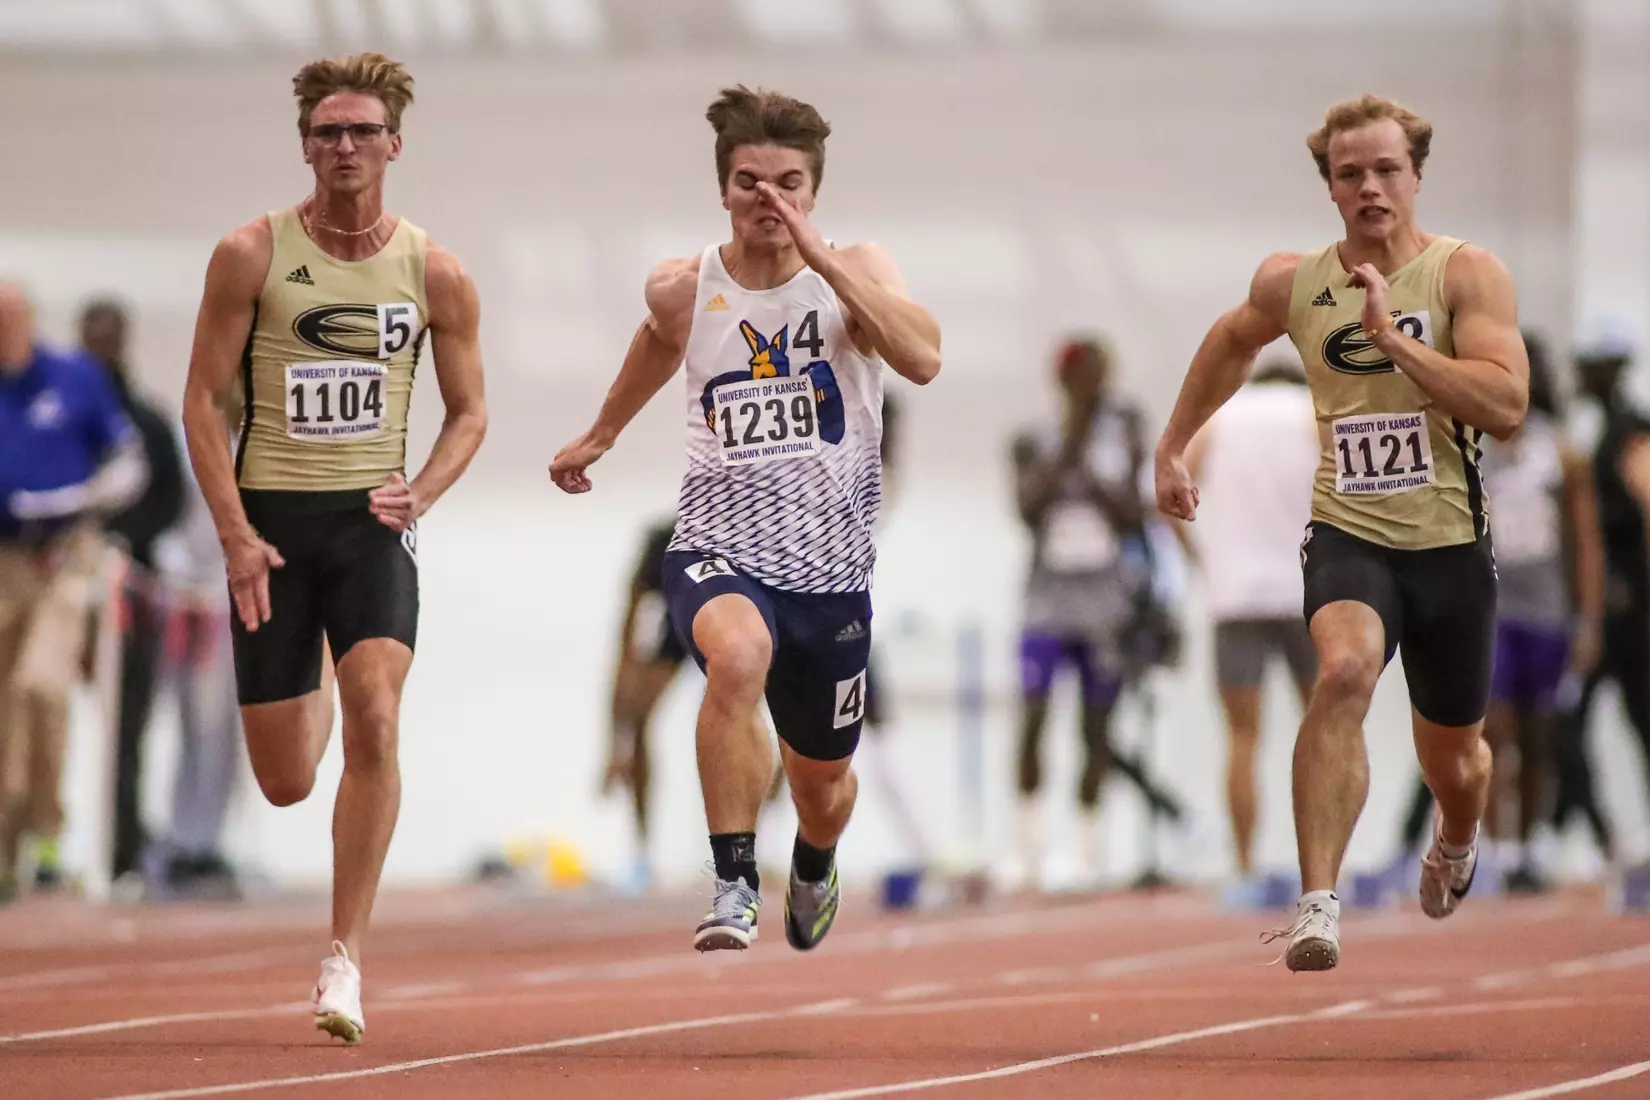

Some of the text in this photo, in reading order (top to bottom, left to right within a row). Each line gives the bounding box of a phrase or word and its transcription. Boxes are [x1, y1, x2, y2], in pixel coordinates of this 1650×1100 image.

[384, 307, 410, 353] 5
[793, 310, 824, 358] 4
[291, 367, 383, 379] UNIVERSITY OF KANSAS
[291, 380, 383, 422] 1104
[718, 381, 808, 403] UNIVERSITY OF KANSAS
[293, 422, 380, 435] JAYHAWK INVITATIONAL
[720, 395, 814, 448] 1239
[1335, 415, 1422, 434] UNIVERSITY OF KANSAS
[726, 441, 814, 461] JAYHAWK INVITATIONAL
[1338, 431, 1428, 478] 1121
[1342, 475, 1430, 492] JAYHAWK INVITATIONAL
[698, 561, 727, 577] 4
[839, 676, 862, 720] 4
